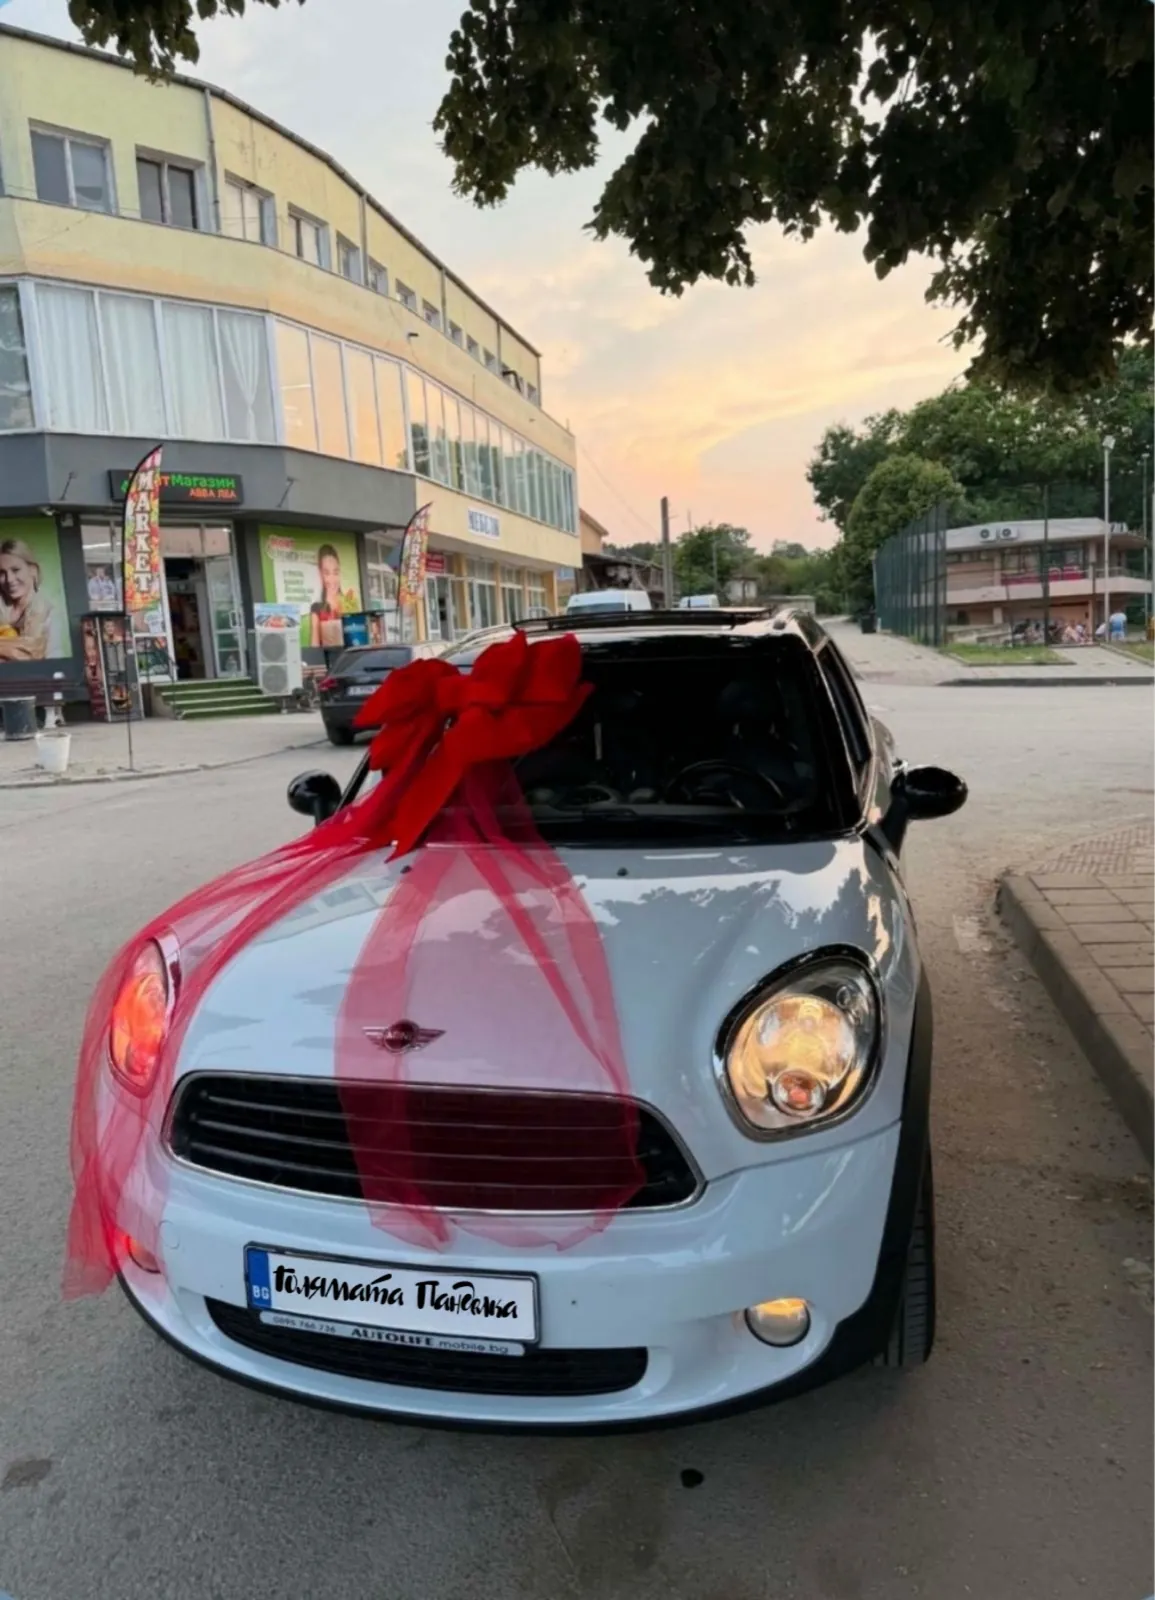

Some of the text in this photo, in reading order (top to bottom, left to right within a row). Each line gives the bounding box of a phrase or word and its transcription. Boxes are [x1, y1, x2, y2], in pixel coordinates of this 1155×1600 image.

[133, 470, 155, 593] MARKET
[408, 514, 426, 595] MARKET
[252, 1285, 270, 1300] BG
[273, 1265, 404, 1306] Голямата
[351, 1328, 509, 1354] AUTOLIFE mobile.bg
